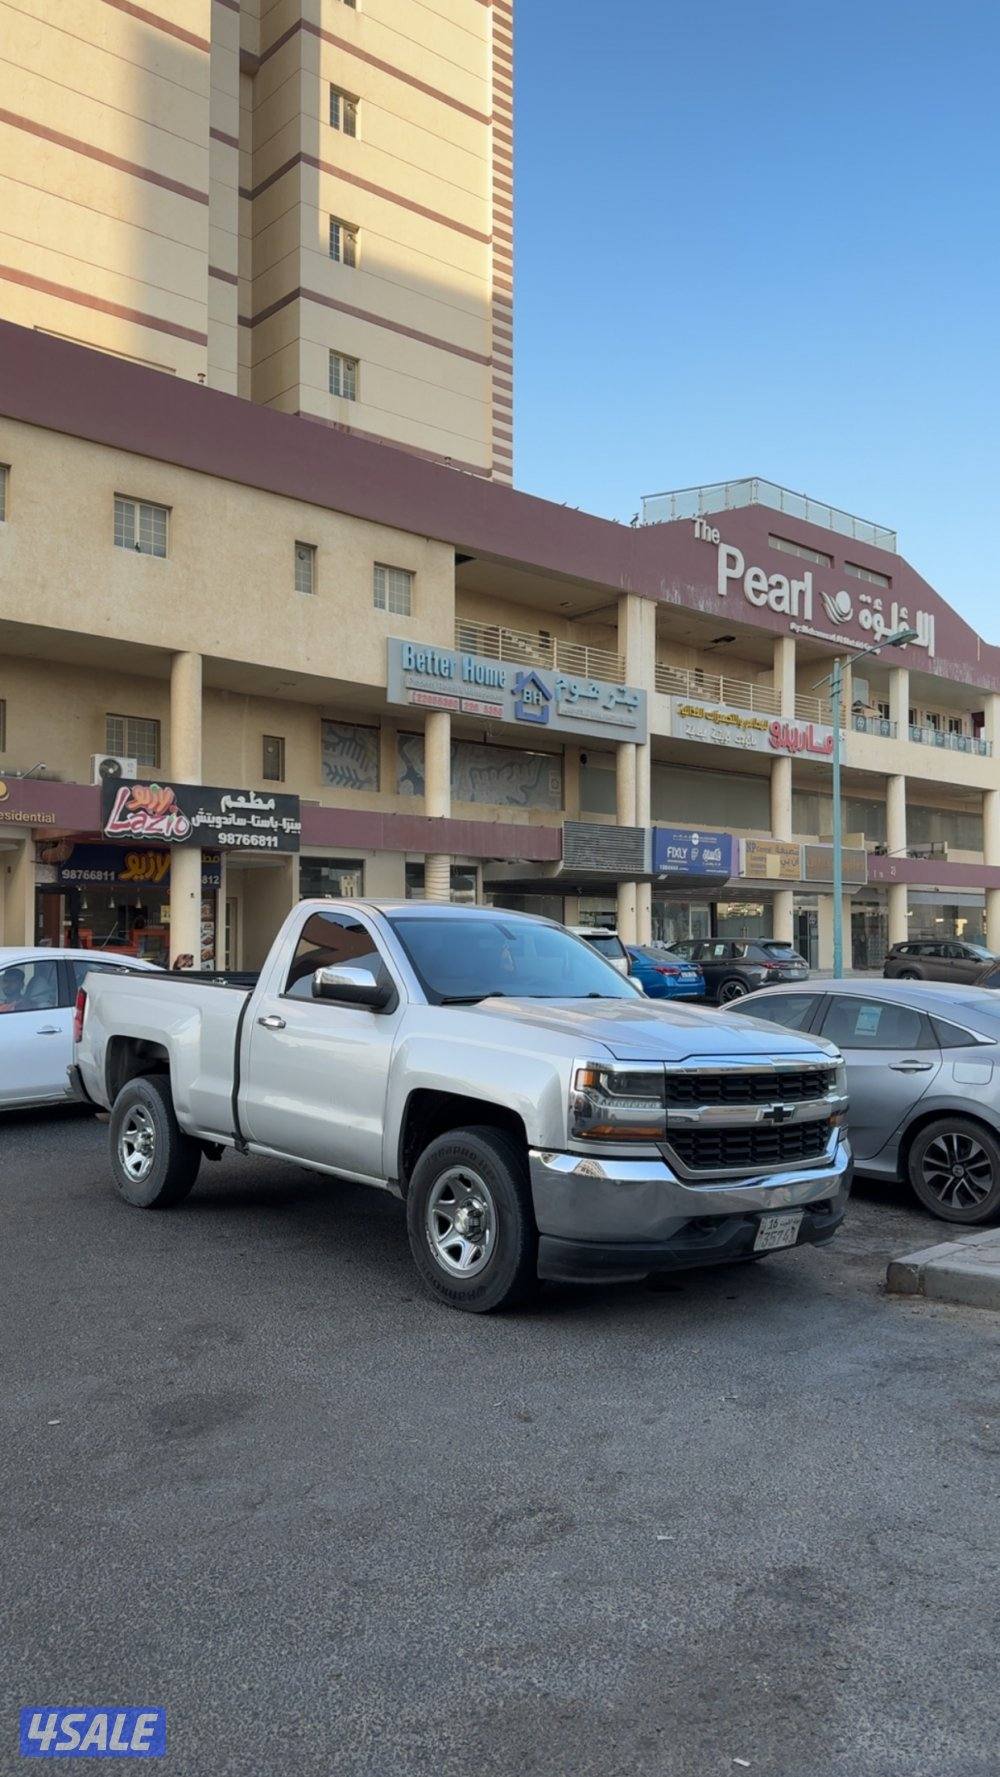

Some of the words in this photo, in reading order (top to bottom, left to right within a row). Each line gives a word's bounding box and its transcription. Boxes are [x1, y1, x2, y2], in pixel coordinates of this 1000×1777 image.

[693, 518, 721, 545] The
[717, 543, 813, 622] Pearl
[858, 594, 935, 657] اللؤلؤة
[402, 644, 456, 679] Better
[462, 656, 506, 689] Home
[524, 688, 541, 705] BH
[768, 721, 834, 755] مارينو
[105, 787, 190, 837] Lazio
[220, 791, 276, 812] مطعم
[0, 809, 55, 824] esidential
[218, 832, 278, 848] 98766811
[61, 869, 115, 881] 98766811
